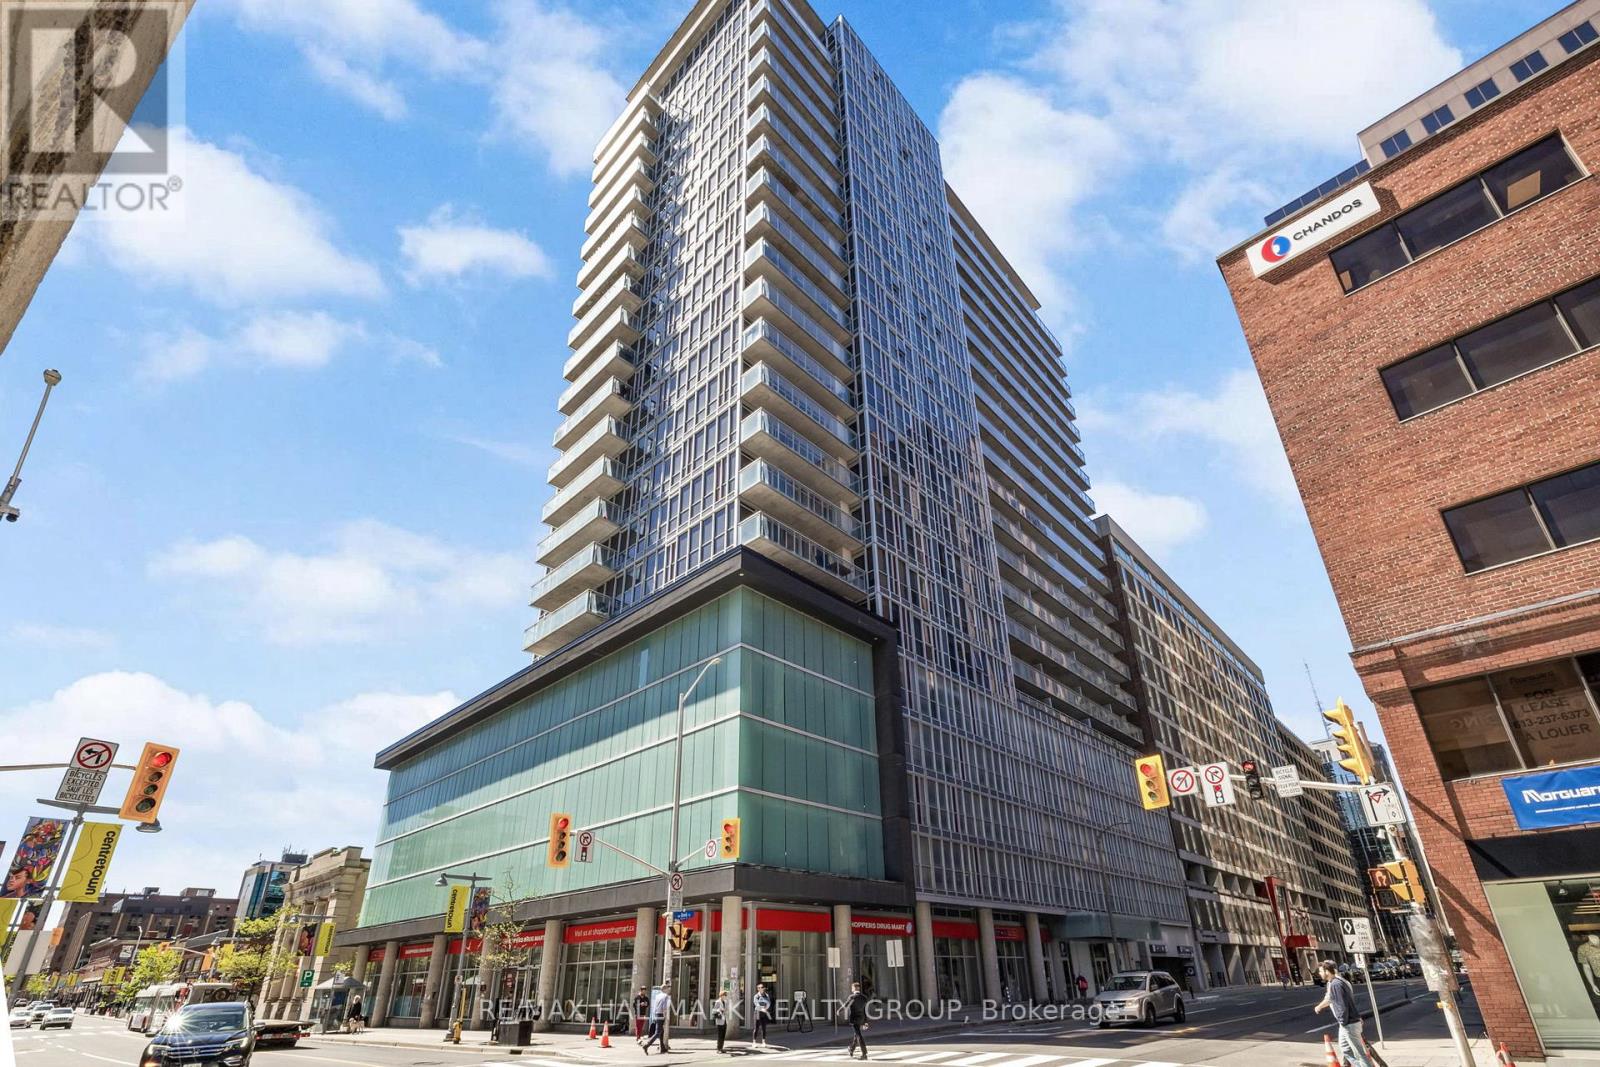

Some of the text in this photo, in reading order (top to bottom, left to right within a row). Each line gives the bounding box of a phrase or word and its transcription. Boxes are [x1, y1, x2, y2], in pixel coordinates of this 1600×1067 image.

[1293, 199, 1362, 240] CHANDOS
[1521, 697, 1570, 713] LEASE
[1514, 709, 1591, 730] 613-237-6373
[1538, 723, 1592, 741] LOUER
[66, 778, 100, 788] EXCEPTED
[69, 770, 104, 781] BICYCLES
[82, 787, 94, 795] LES
[85, 830, 116, 896] centretown
